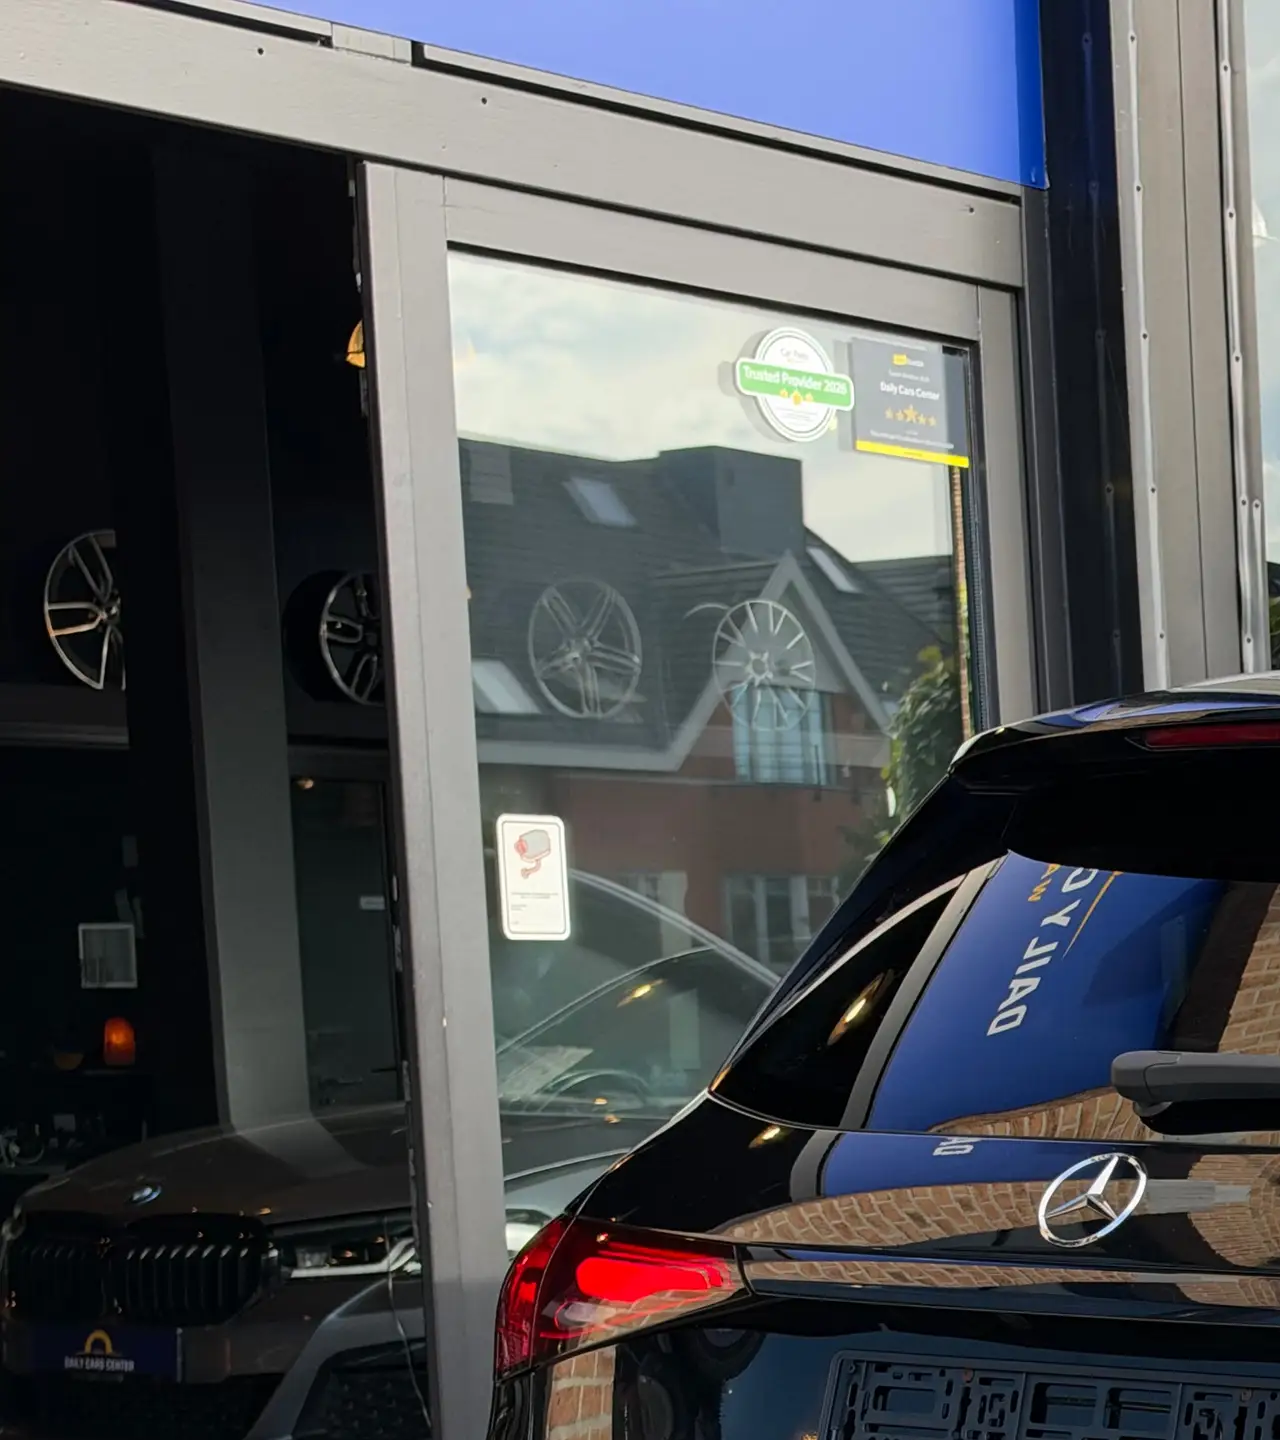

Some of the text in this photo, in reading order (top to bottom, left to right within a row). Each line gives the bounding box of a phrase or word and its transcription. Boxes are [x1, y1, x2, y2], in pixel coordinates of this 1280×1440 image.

[742, 364, 780, 385] Trusted
[781, 371, 822, 392] Provider
[880, 380, 940, 401] Daily Cars Center
